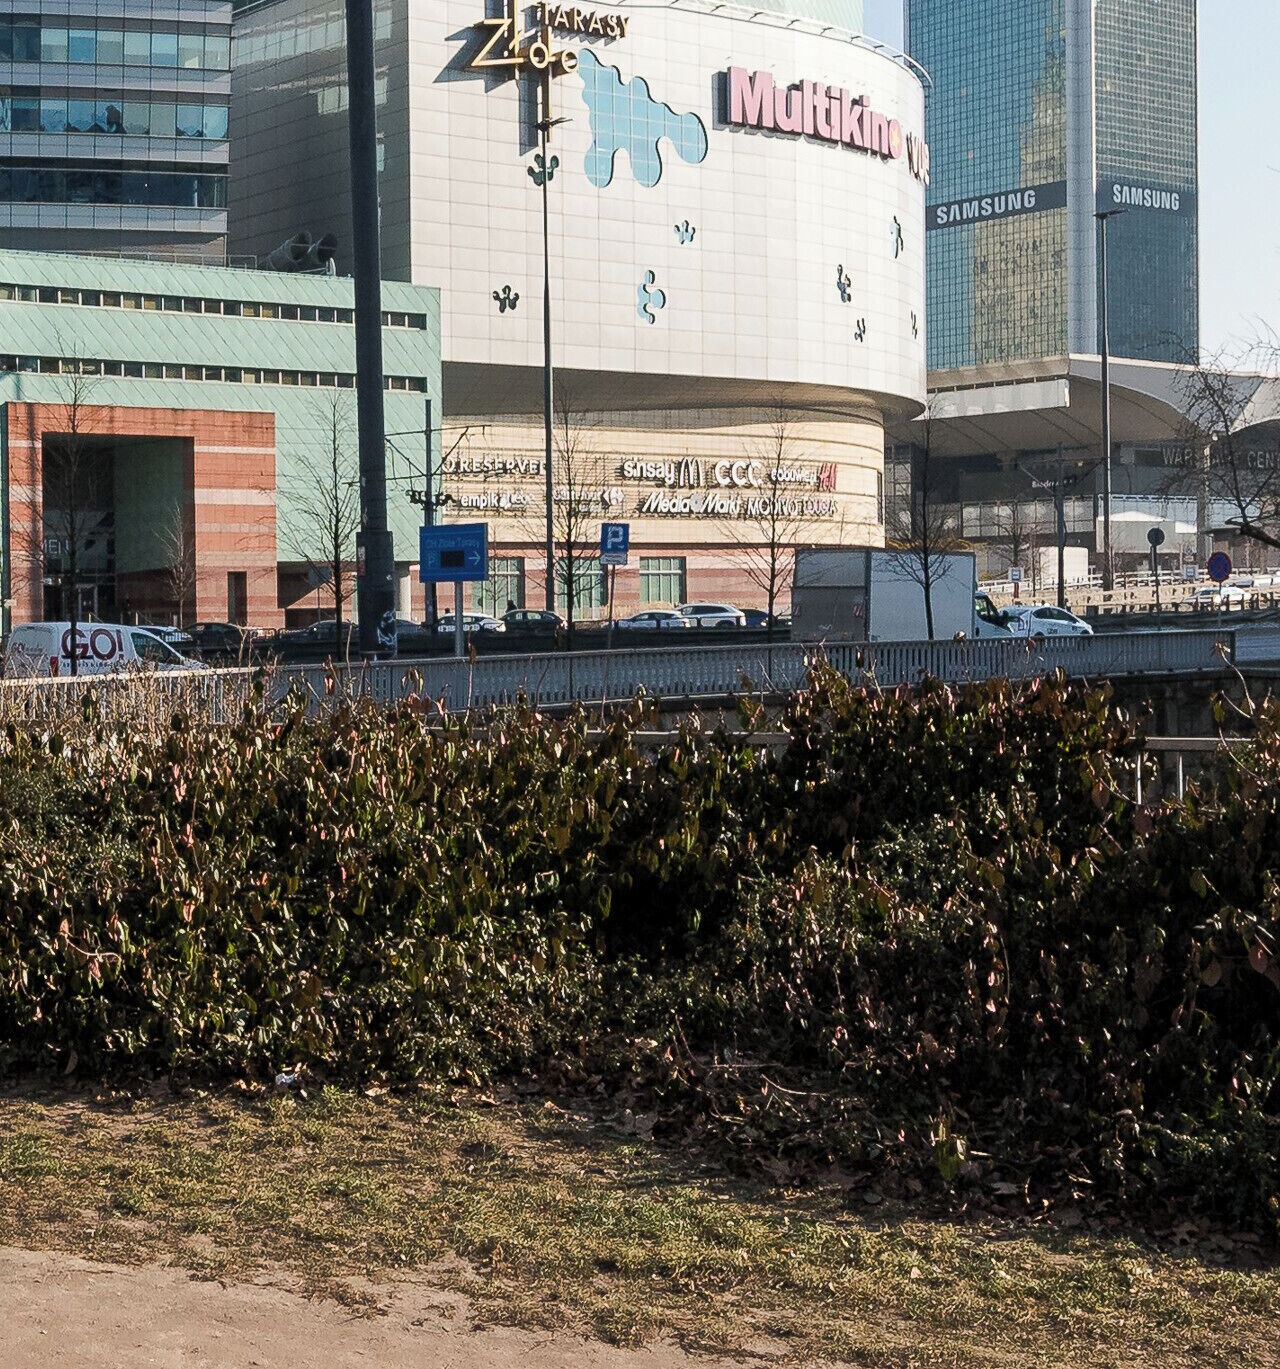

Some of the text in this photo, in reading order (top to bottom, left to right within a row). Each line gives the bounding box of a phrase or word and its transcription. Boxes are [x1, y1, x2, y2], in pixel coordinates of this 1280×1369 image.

[539, 1, 630, 40] TARASY
[727, 66, 903, 160] Multikino
[935, 188, 1037, 224] SAMSUNG
[1112, 183, 1181, 211] SAMSUNG
[623, 460, 675, 484] sinsay
[714, 458, 764, 487] CCC
[460, 491, 499, 509] empik
[641, 491, 742, 515] Media Markt
[61, 627, 125, 662] GO!
